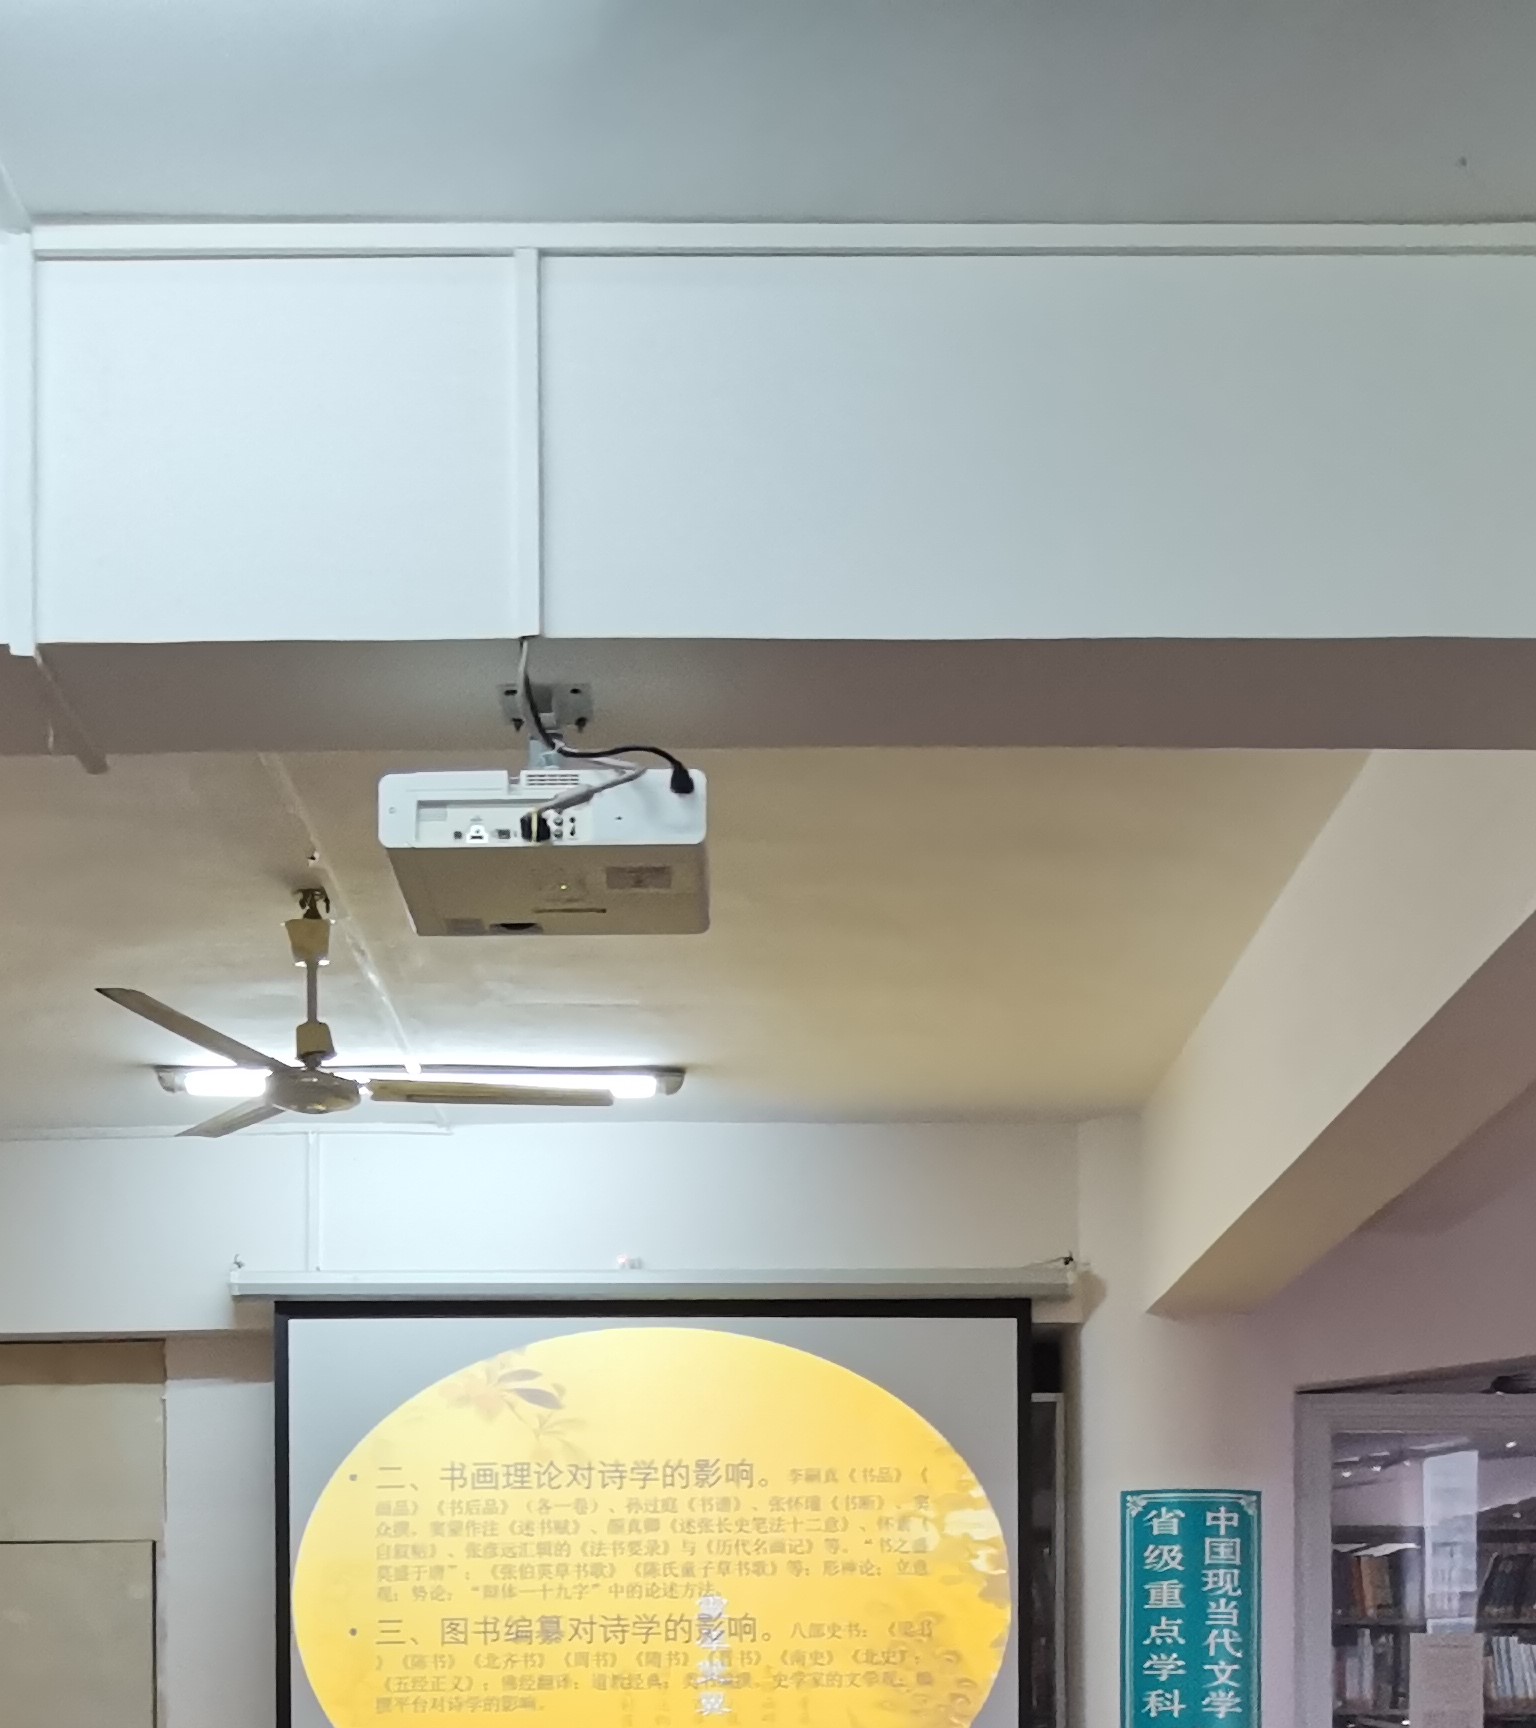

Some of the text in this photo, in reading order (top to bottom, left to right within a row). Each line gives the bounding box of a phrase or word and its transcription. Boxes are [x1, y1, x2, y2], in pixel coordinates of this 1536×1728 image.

[1142, 1505, 1186, 1719] 省级重点学科
[1201, 1505, 1243, 1719] 中国现当代文学
